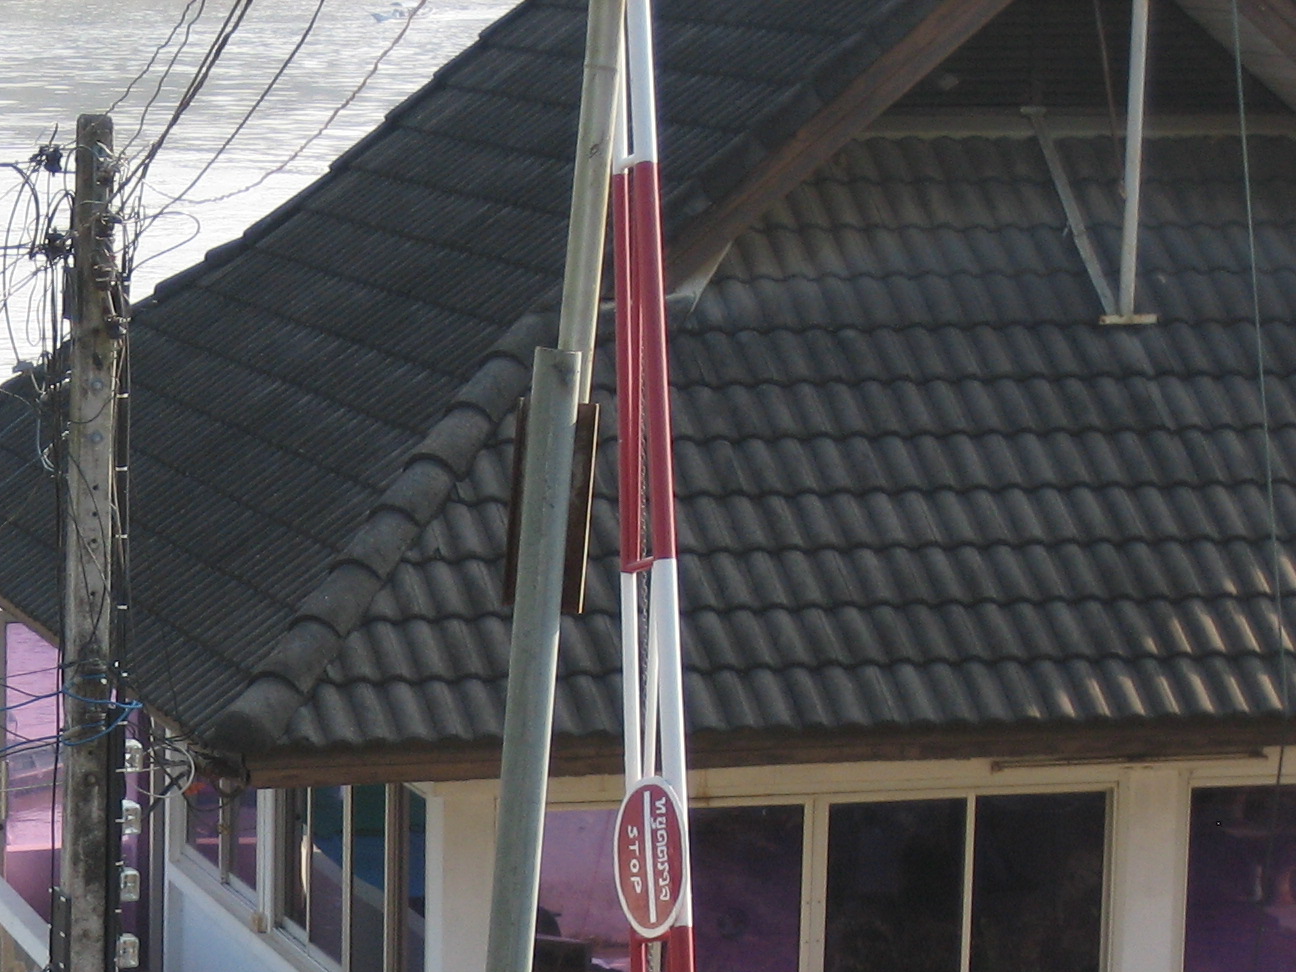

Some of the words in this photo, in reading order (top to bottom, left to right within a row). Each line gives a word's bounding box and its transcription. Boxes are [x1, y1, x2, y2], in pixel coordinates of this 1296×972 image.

[627, 825, 643, 895] STOP
[651, 796, 671, 902] หยุดตรวจ
